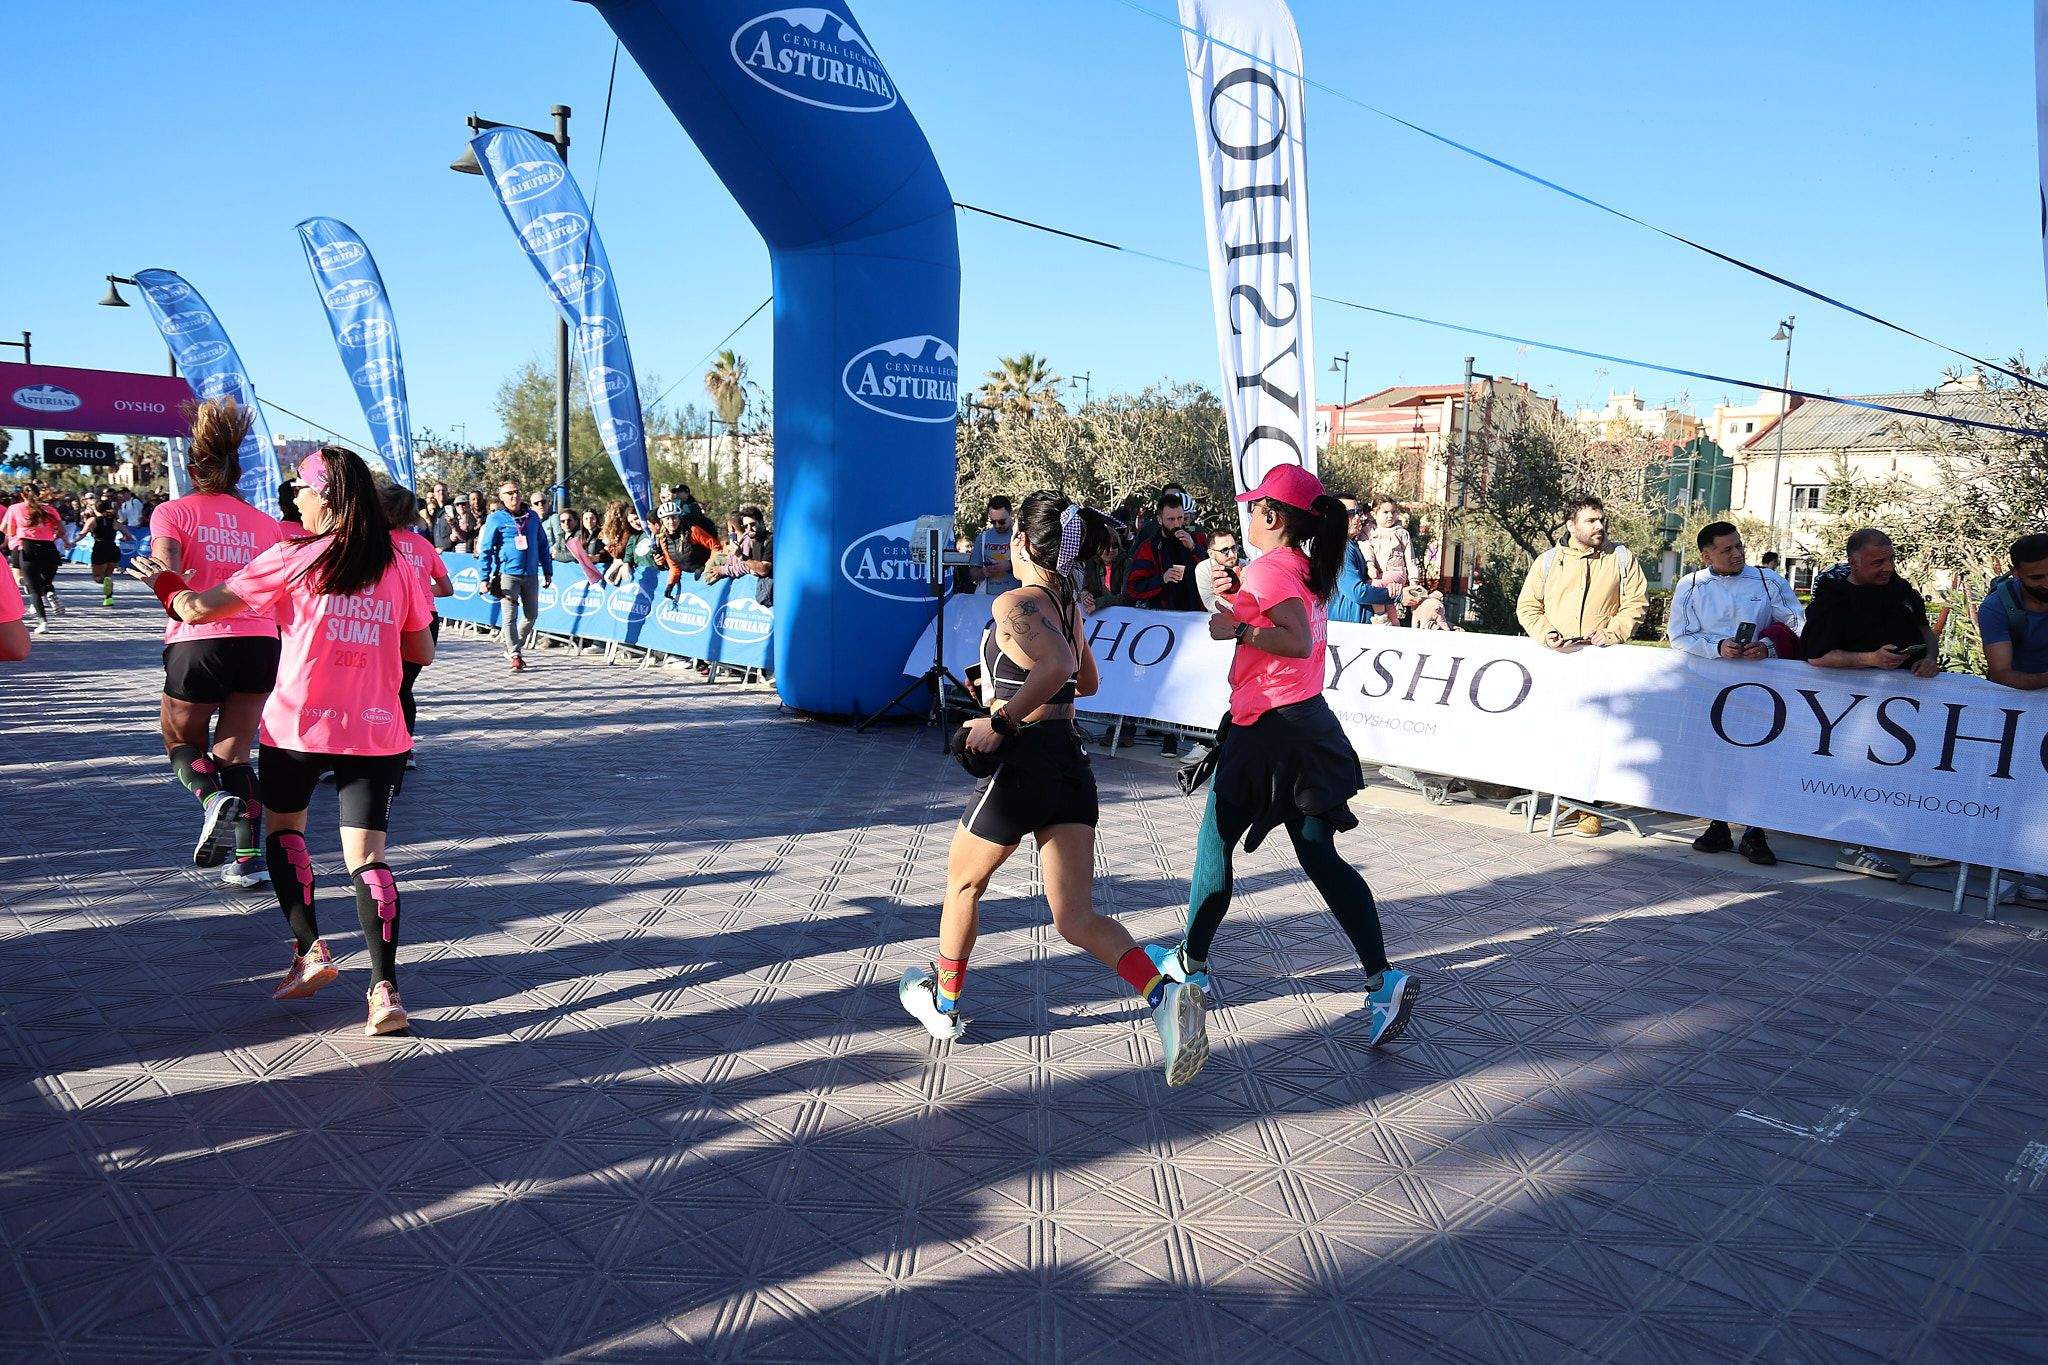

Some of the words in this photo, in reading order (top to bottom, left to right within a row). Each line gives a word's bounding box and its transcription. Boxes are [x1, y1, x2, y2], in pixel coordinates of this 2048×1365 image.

[783, 33, 839, 55] CENTRAL
[745, 31, 892, 100] ASTURIANA
[885, 362, 935, 374] CENTRAL
[856, 362, 957, 402] ASTURIAN
[18, 392, 77, 407] ASTURIANA
[114, 400, 165, 413] OYSHO
[54, 446, 107, 460] OYSHO
[216, 512, 238, 529] TU
[197, 525, 259, 550] DORSAL
[399, 541, 413, 554] TU
[205, 544, 252, 565] SUMA
[326, 617, 381, 647] SUMA
[334, 649, 368, 669] 2025
[1325, 644, 1533, 714] YSHO
[1710, 682, 2048, 781] OYSH
[1800, 777, 2000, 821] WWW.OYSHO.COM
